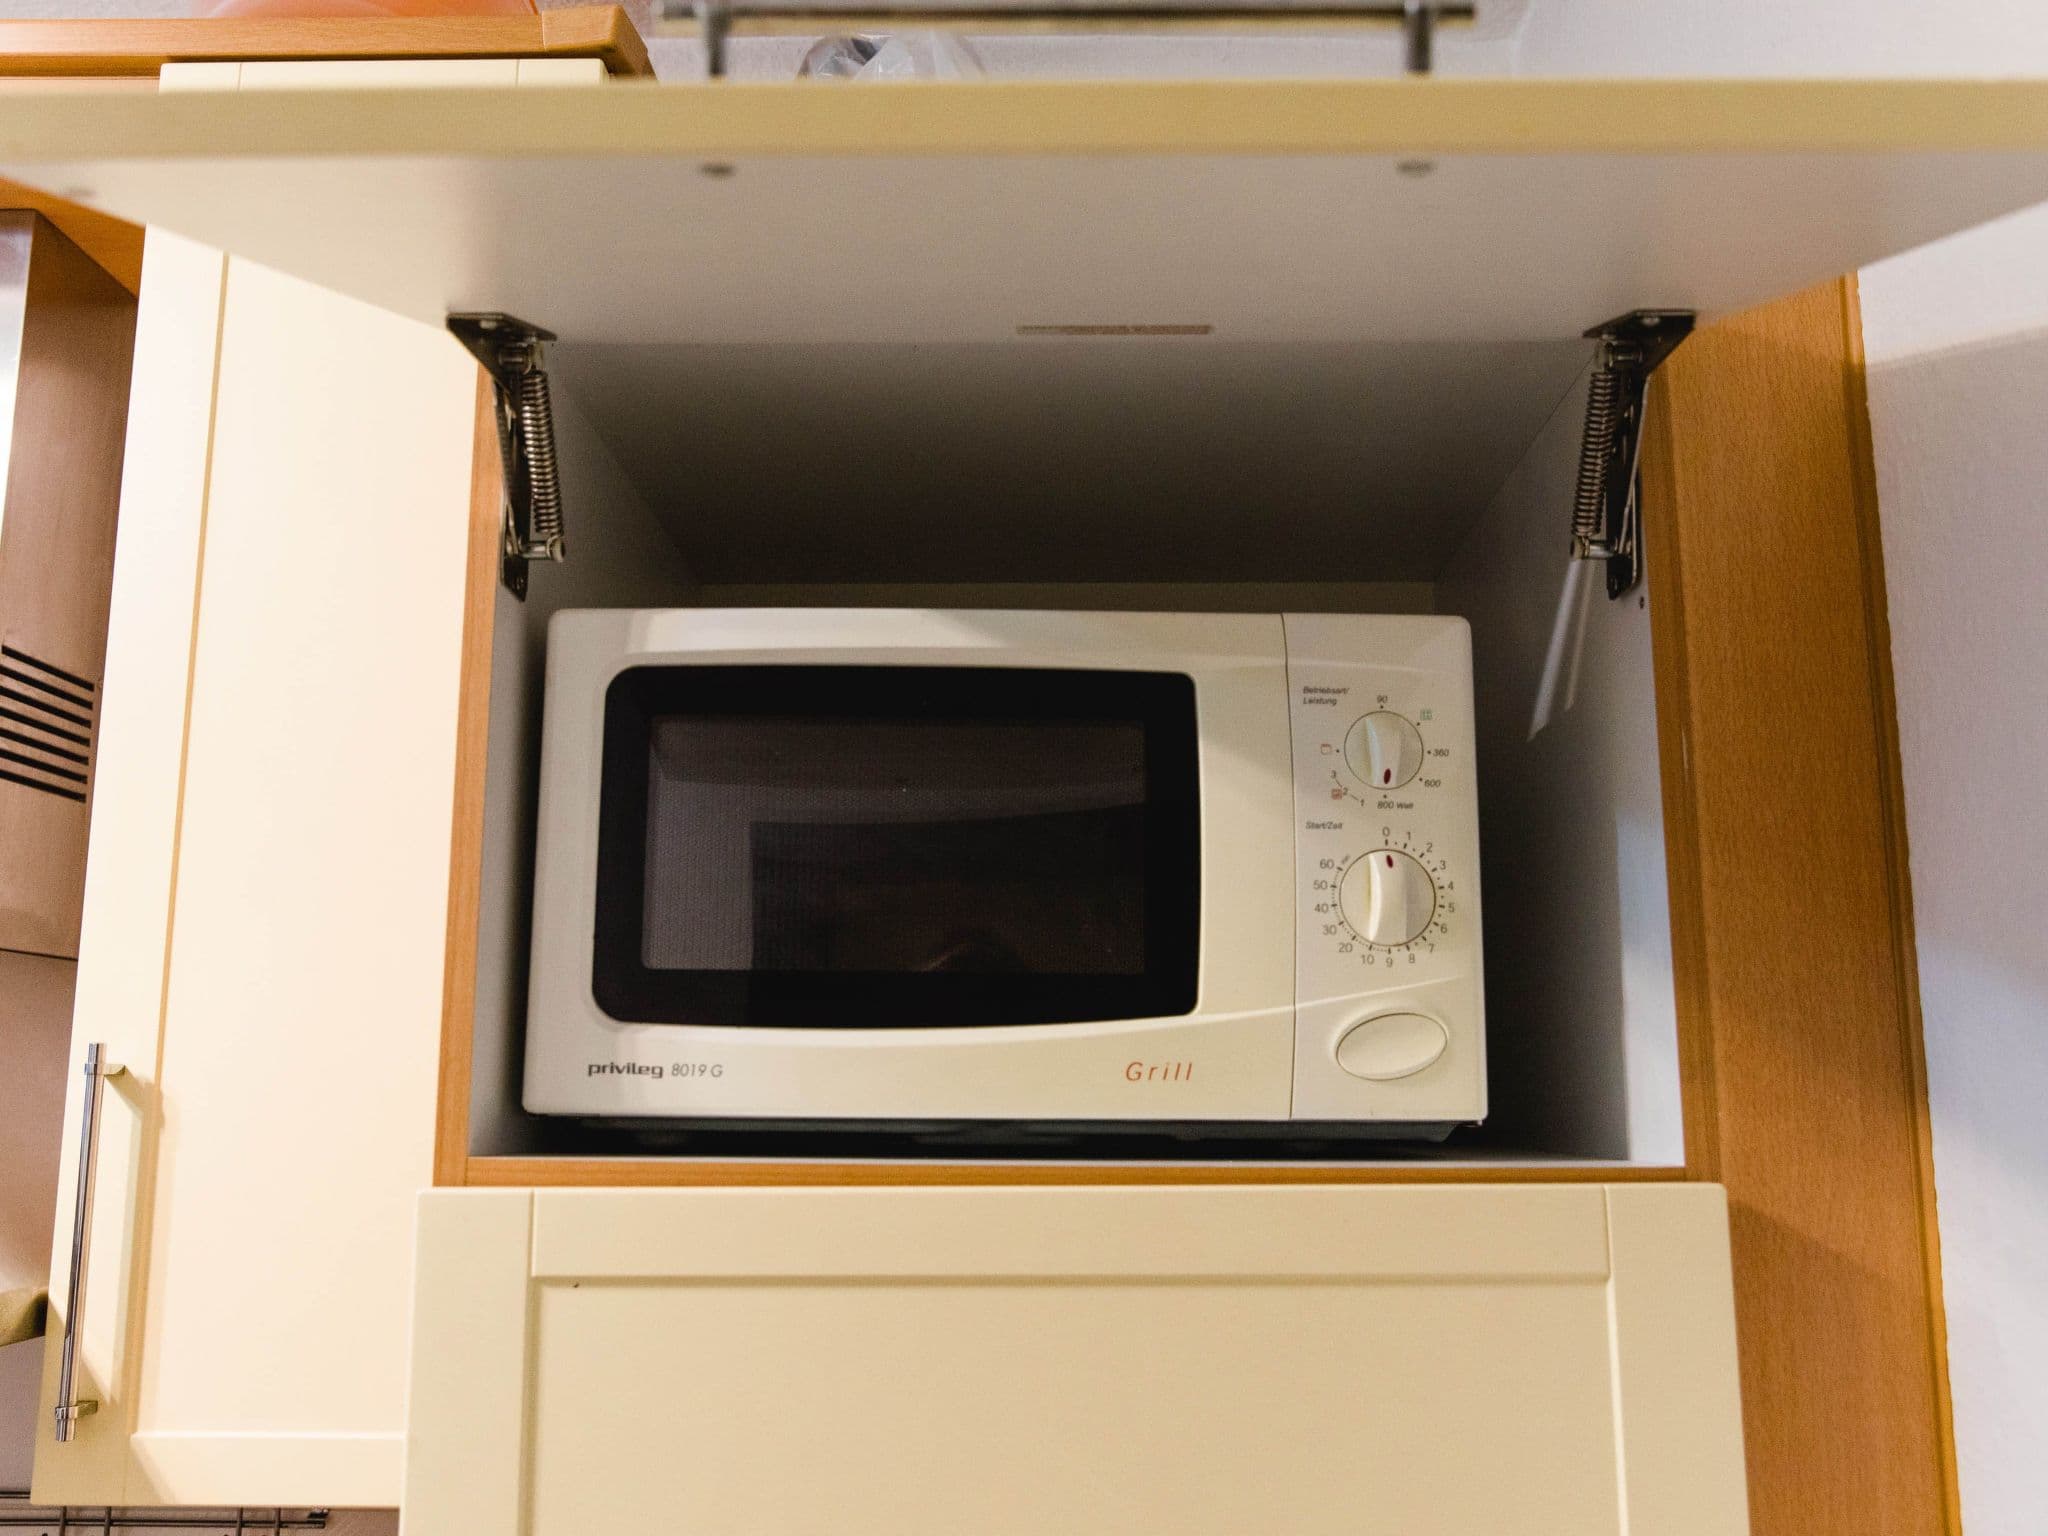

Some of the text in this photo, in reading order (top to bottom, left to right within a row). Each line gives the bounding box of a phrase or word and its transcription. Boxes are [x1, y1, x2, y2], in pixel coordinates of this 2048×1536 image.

[1303, 697, 1337, 706] Leistung
[1376, 695, 1388, 704] 90
[1432, 748, 1450, 757] 360
[1424, 779, 1441, 788] 600
[1382, 827, 1390, 837] 0
[1406, 831, 1411, 840] 1
[1426, 843, 1433, 852] 2
[1320, 859, 1334, 869] 60
[1440, 860, 1446, 870] 3
[1313, 880, 1328, 890] 50
[1448, 881, 1454, 891] 4
[1314, 903, 1329, 913] 40
[1448, 903, 1455, 912] 5
[1322, 925, 1337, 935] 30
[1440, 923, 1447, 933] 6
[1338, 943, 1353, 953] 20
[1428, 943, 1435, 953] 7
[1361, 955, 1375, 965] 10
[1386, 957, 1393, 967] 9
[1408, 954, 1415, 964] 8
[588, 1062, 723, 1079] privileg 8019 G
[1126, 1061, 1192, 1081] Grill
